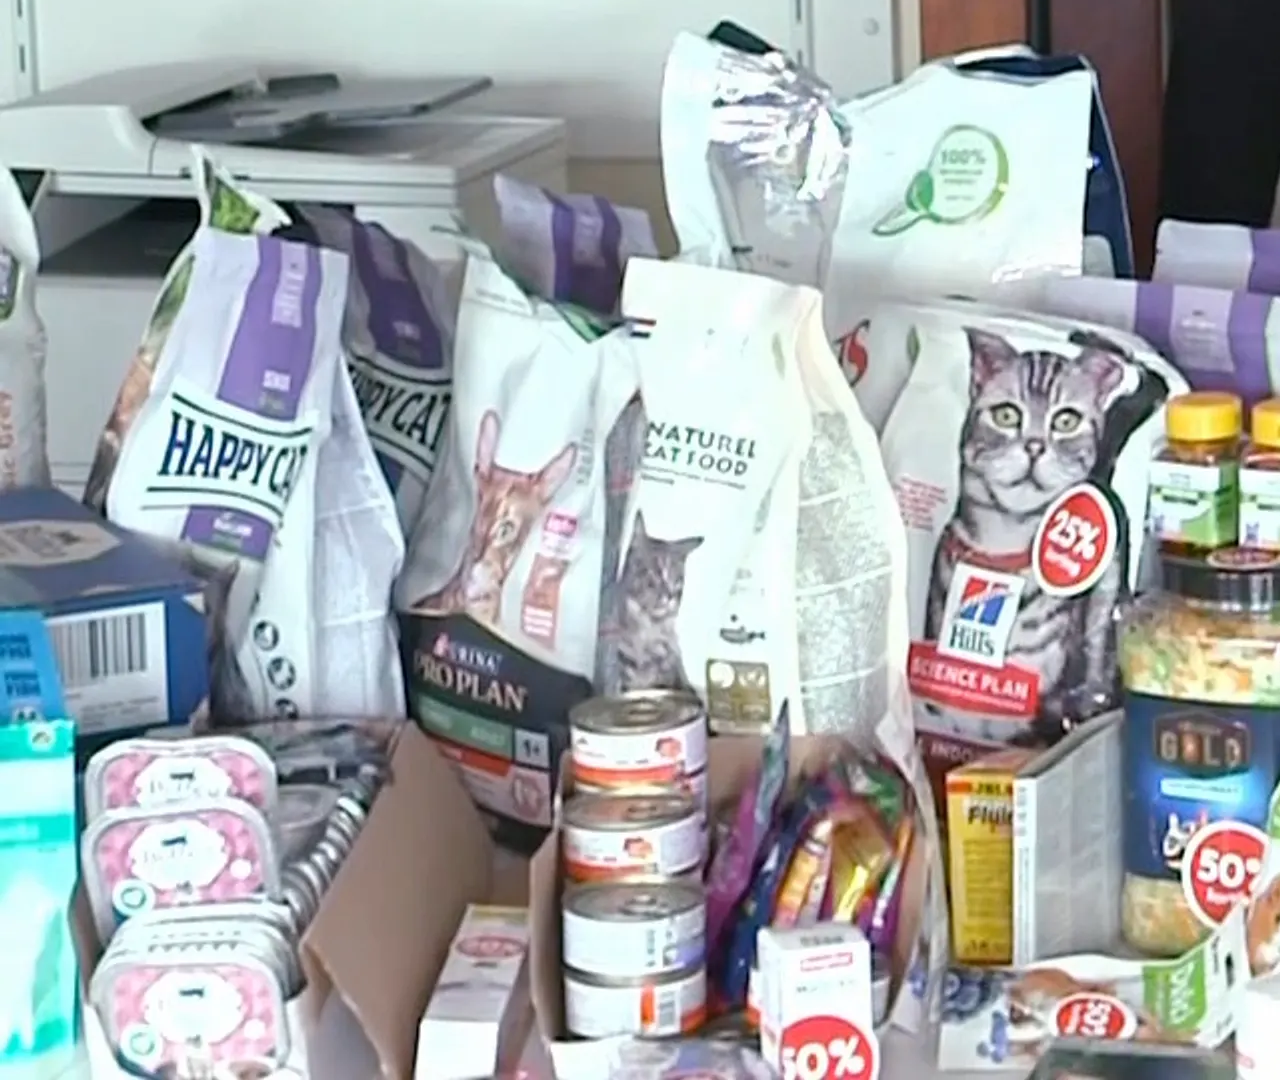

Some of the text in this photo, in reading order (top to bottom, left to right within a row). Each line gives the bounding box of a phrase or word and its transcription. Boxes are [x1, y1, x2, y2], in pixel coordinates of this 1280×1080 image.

[157, 409, 275, 486] HAPPY
[645, 421, 756, 459] NATUREL
[686, 450, 749, 477] FOOD
[1048, 508, 1102, 562] 25%
[950, 624, 996, 658] Hill's
[455, 671, 528, 713] PLAN
[911, 654, 1029, 700] SCIENCE PLAN
